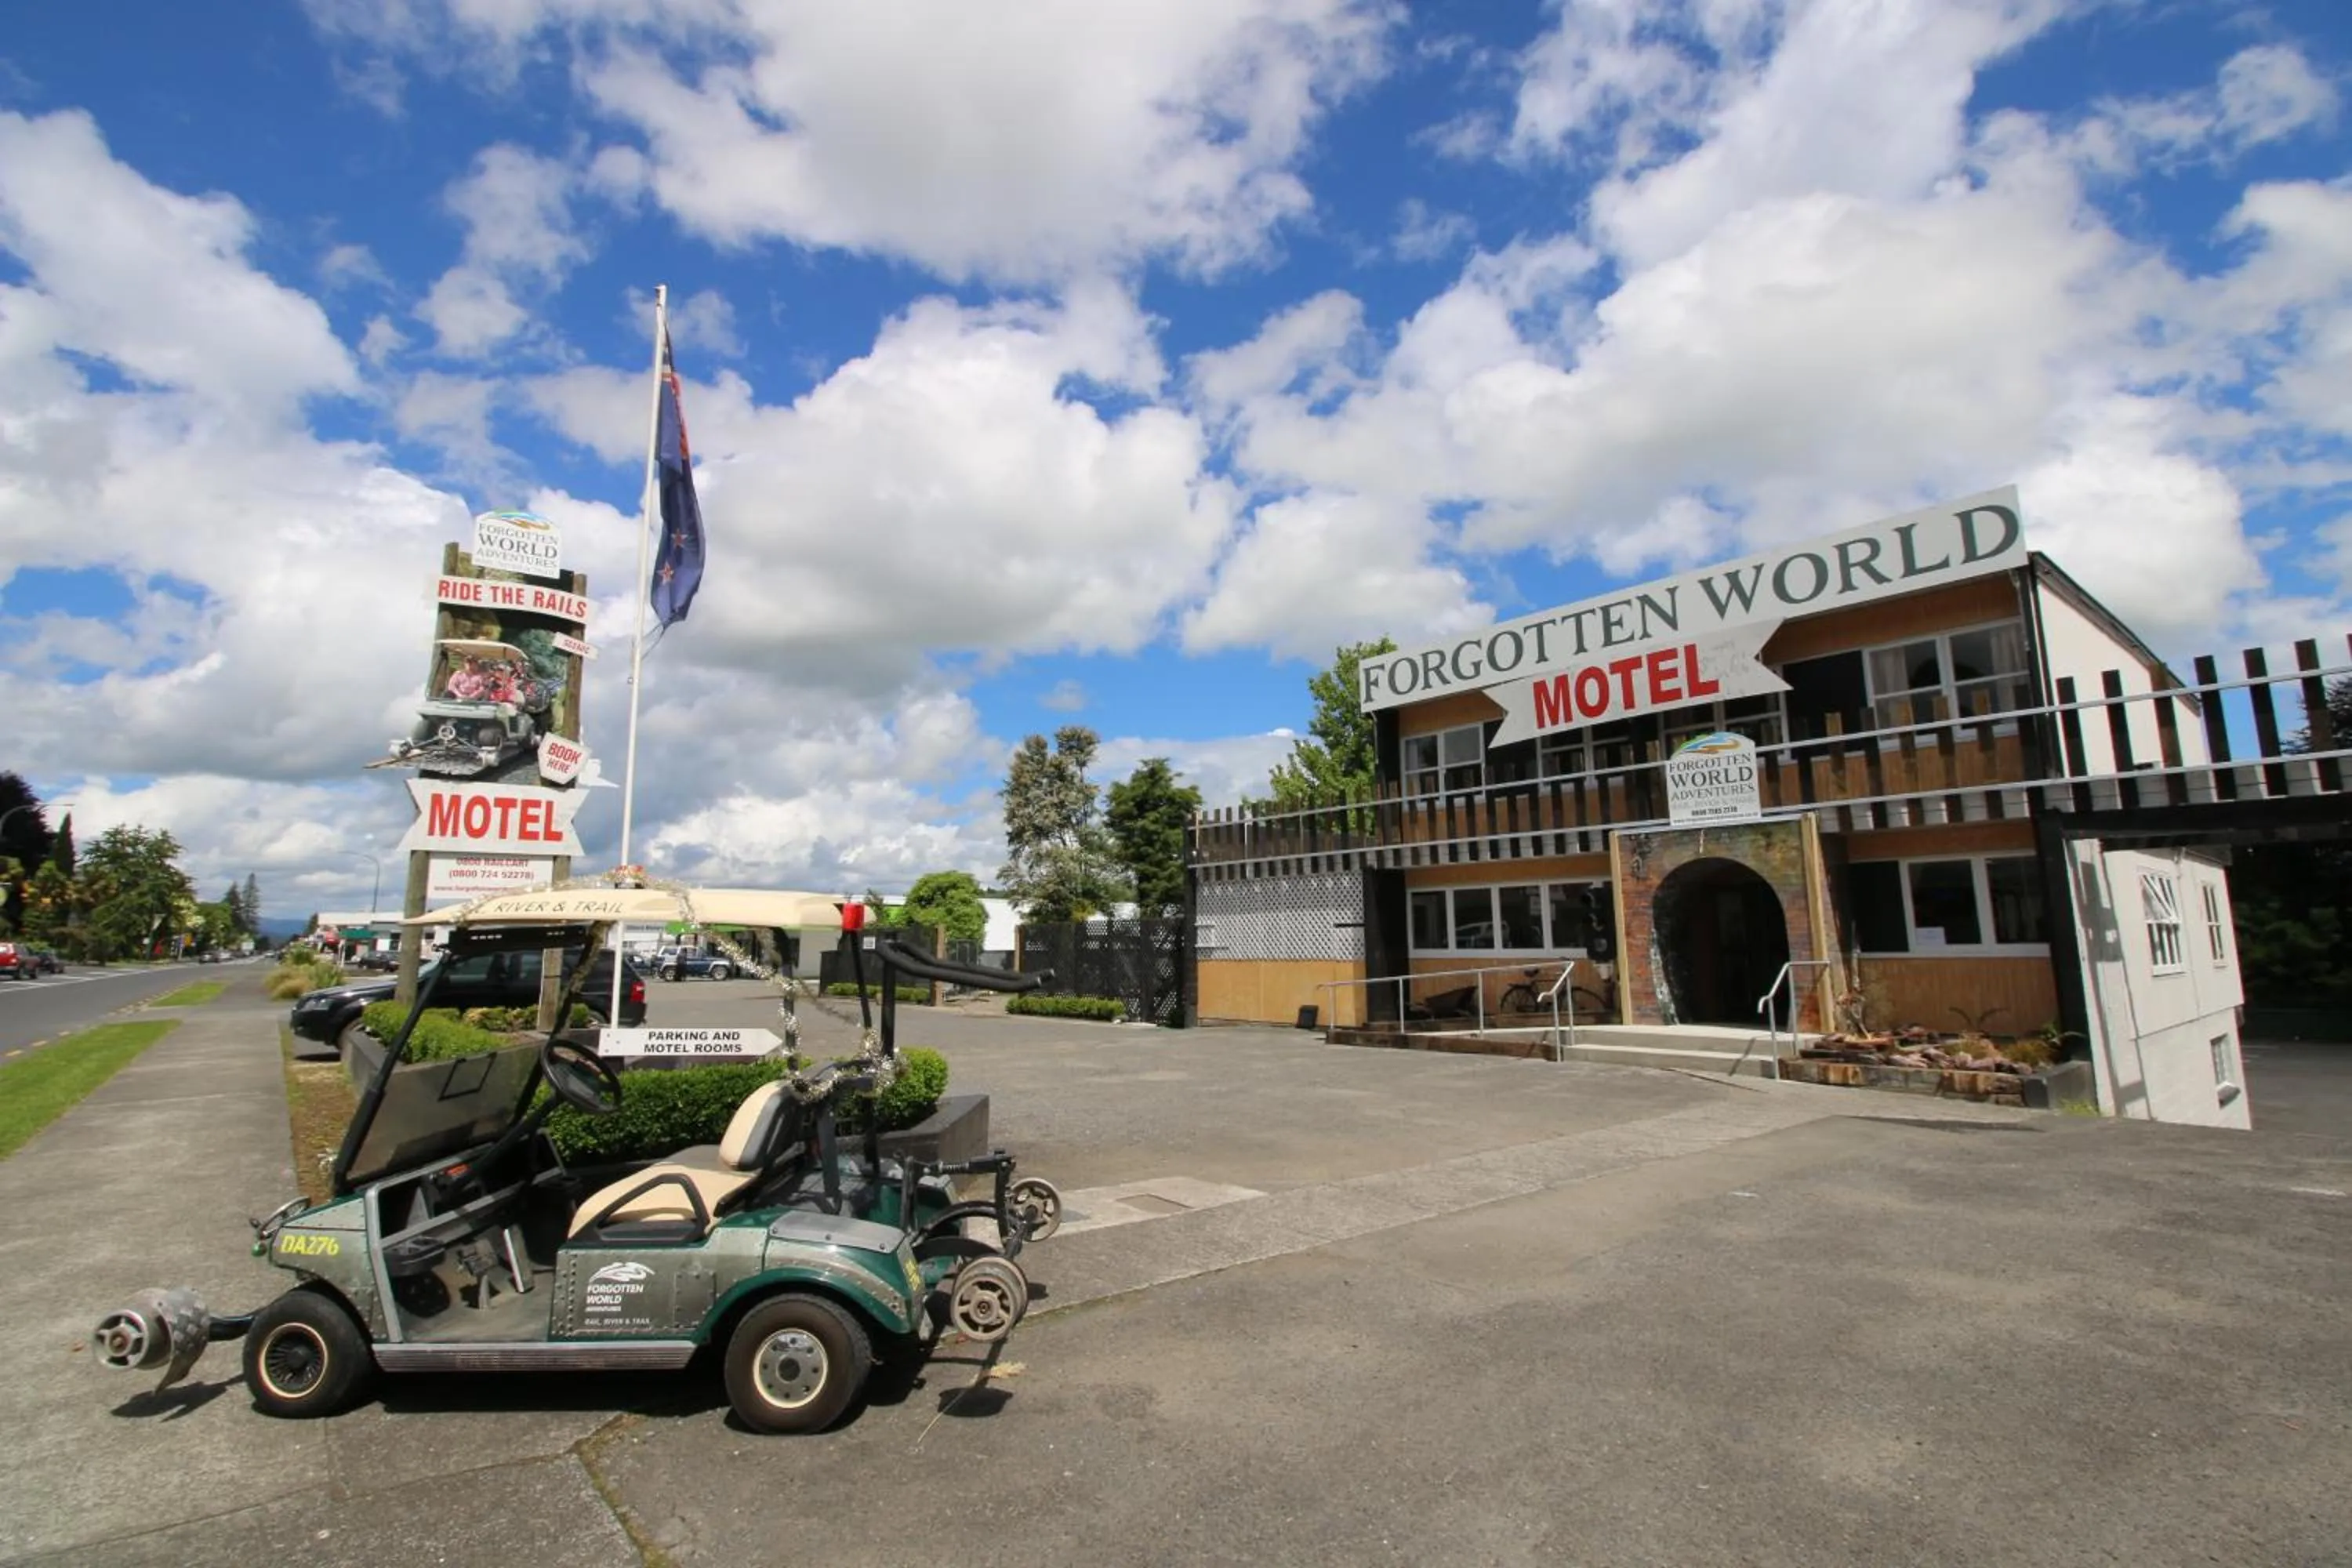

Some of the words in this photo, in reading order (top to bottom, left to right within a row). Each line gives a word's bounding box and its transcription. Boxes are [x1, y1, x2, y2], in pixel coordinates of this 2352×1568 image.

[478, 522, 558, 545] FORGOTTEN
[478, 533, 558, 558] WORLD
[477, 547, 557, 568] ADVENTURES
[437, 579, 483, 602] RIDE
[490, 586, 524, 605] THE
[533, 590, 587, 618] RAILS
[1362, 586, 1680, 703] FORGOTTEN
[1698, 504, 2020, 621] WORLD
[1533, 643, 1719, 729] MOTEL
[548, 742, 582, 764] BOOK
[1668, 753, 1751, 773] FORGOTTEN
[546, 757, 572, 774] HERE
[1670, 766, 1753, 789] WORLD
[1671, 782, 1756, 801] ADVENTURES
[427, 793, 563, 841] MOTEL
[449, 870, 477, 879] (0800
[481, 870, 499, 879] 724
[494, 902, 545, 913] RIVER
[552, 901, 565, 912] &
[574, 902, 624, 914] TRAIL
[648, 1031, 708, 1041] PARKING
[712, 1031, 741, 1041] AND
[643, 1044, 690, 1053] MOTEL
[694, 1044, 743, 1053] ROOMS
[281, 1235, 339, 1256] DA276
[586, 1294, 622, 1304] WORLD
[587, 1283, 644, 1294] FORGOTTEN
